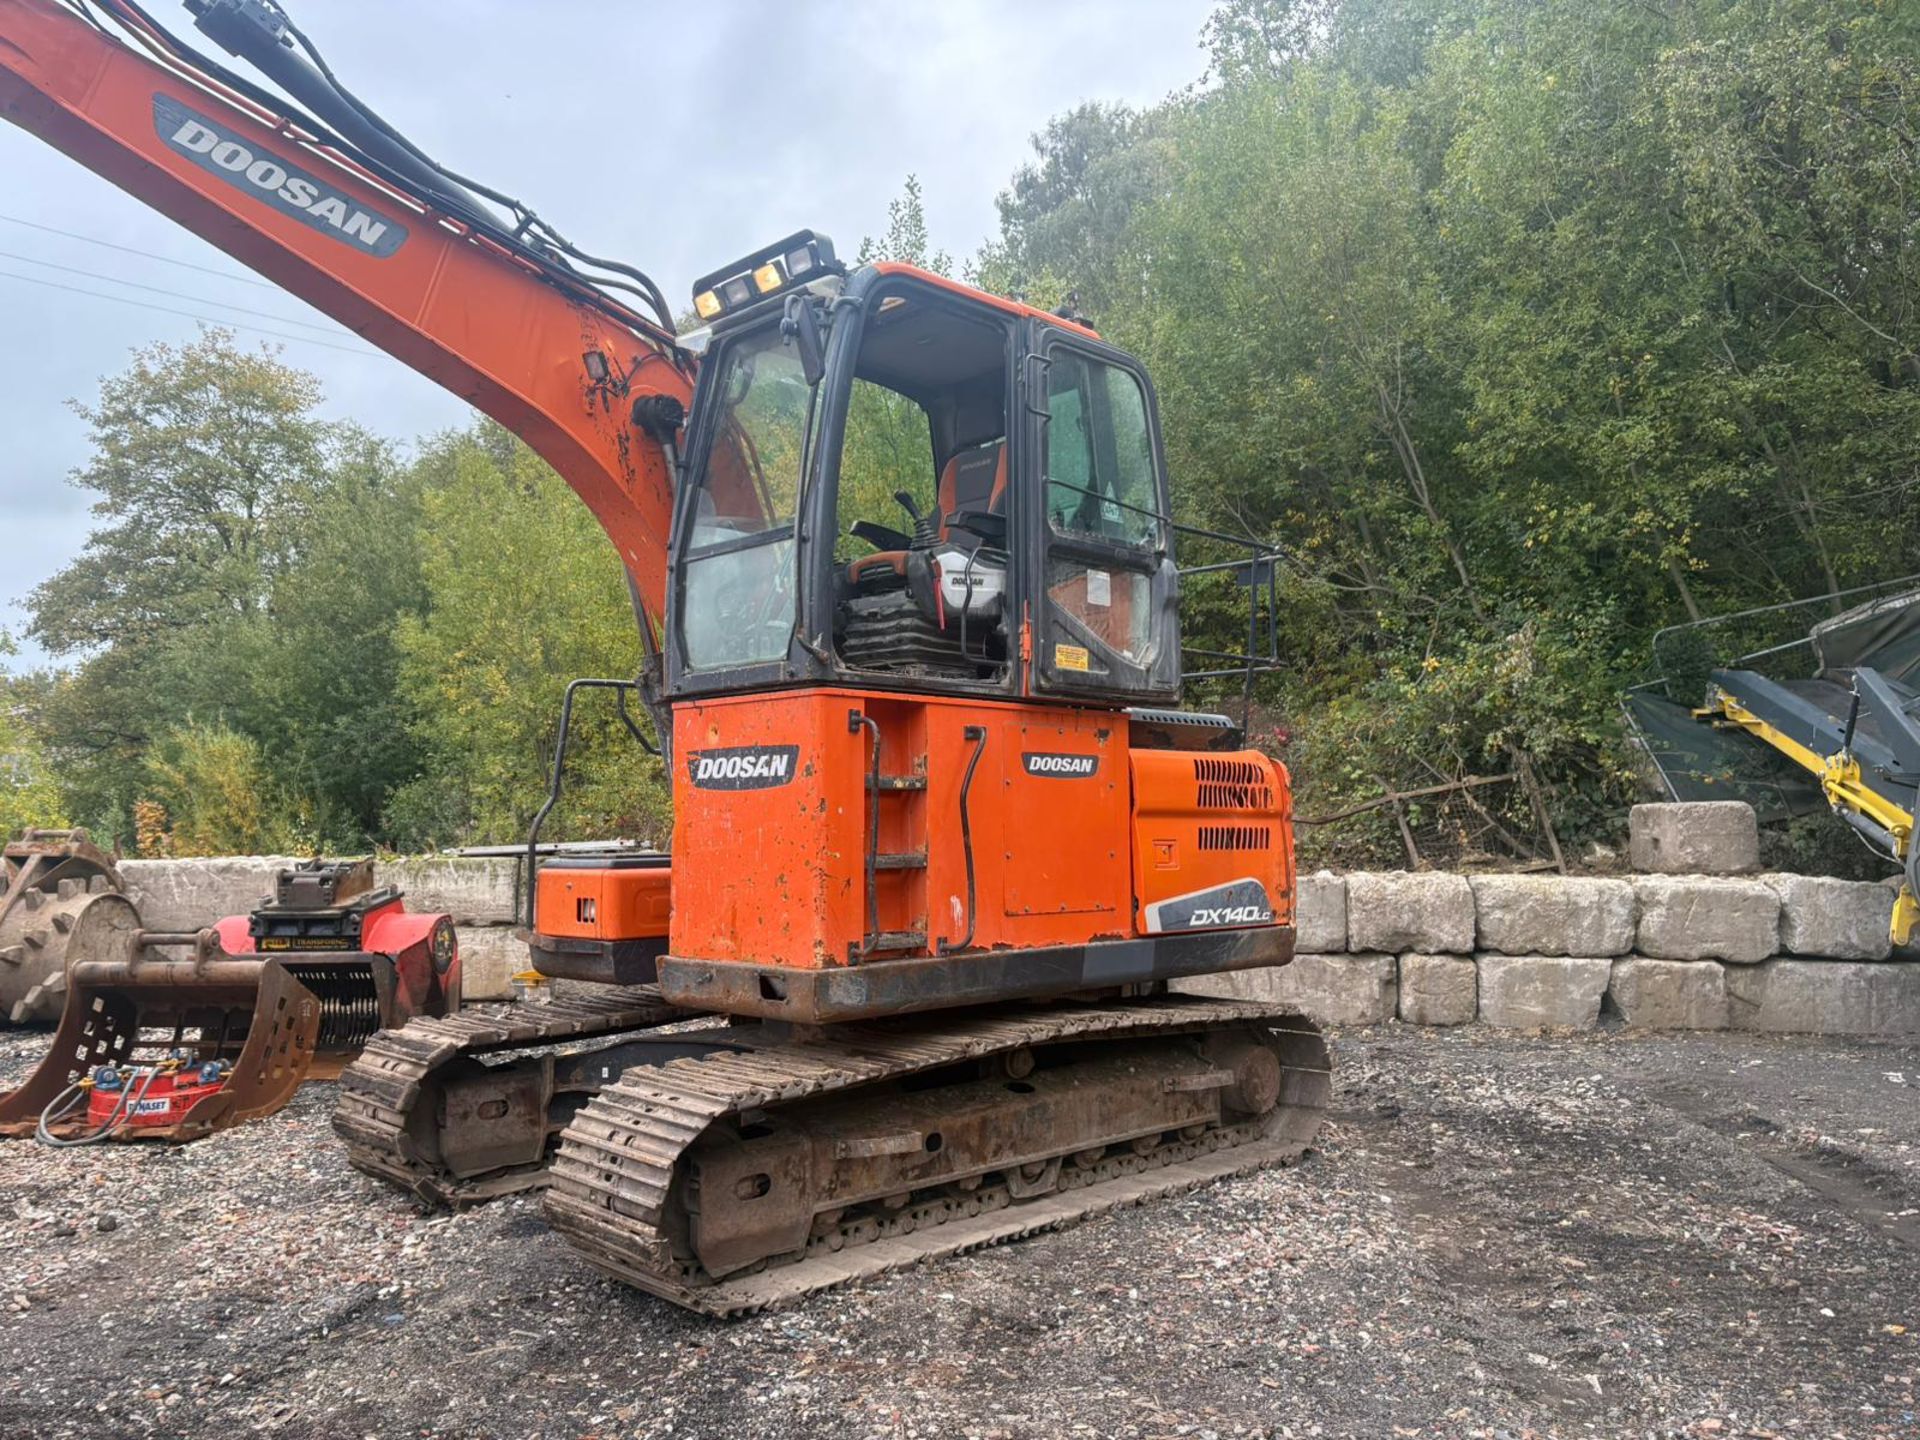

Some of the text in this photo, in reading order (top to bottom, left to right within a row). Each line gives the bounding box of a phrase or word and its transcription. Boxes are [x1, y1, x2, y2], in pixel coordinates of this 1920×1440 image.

[171, 120, 388, 246] DOOSAN
[696, 754, 790, 780] DOOSAN
[1029, 756, 1093, 773] DOOSAN
[128, 1101, 166, 1113] DNASET
